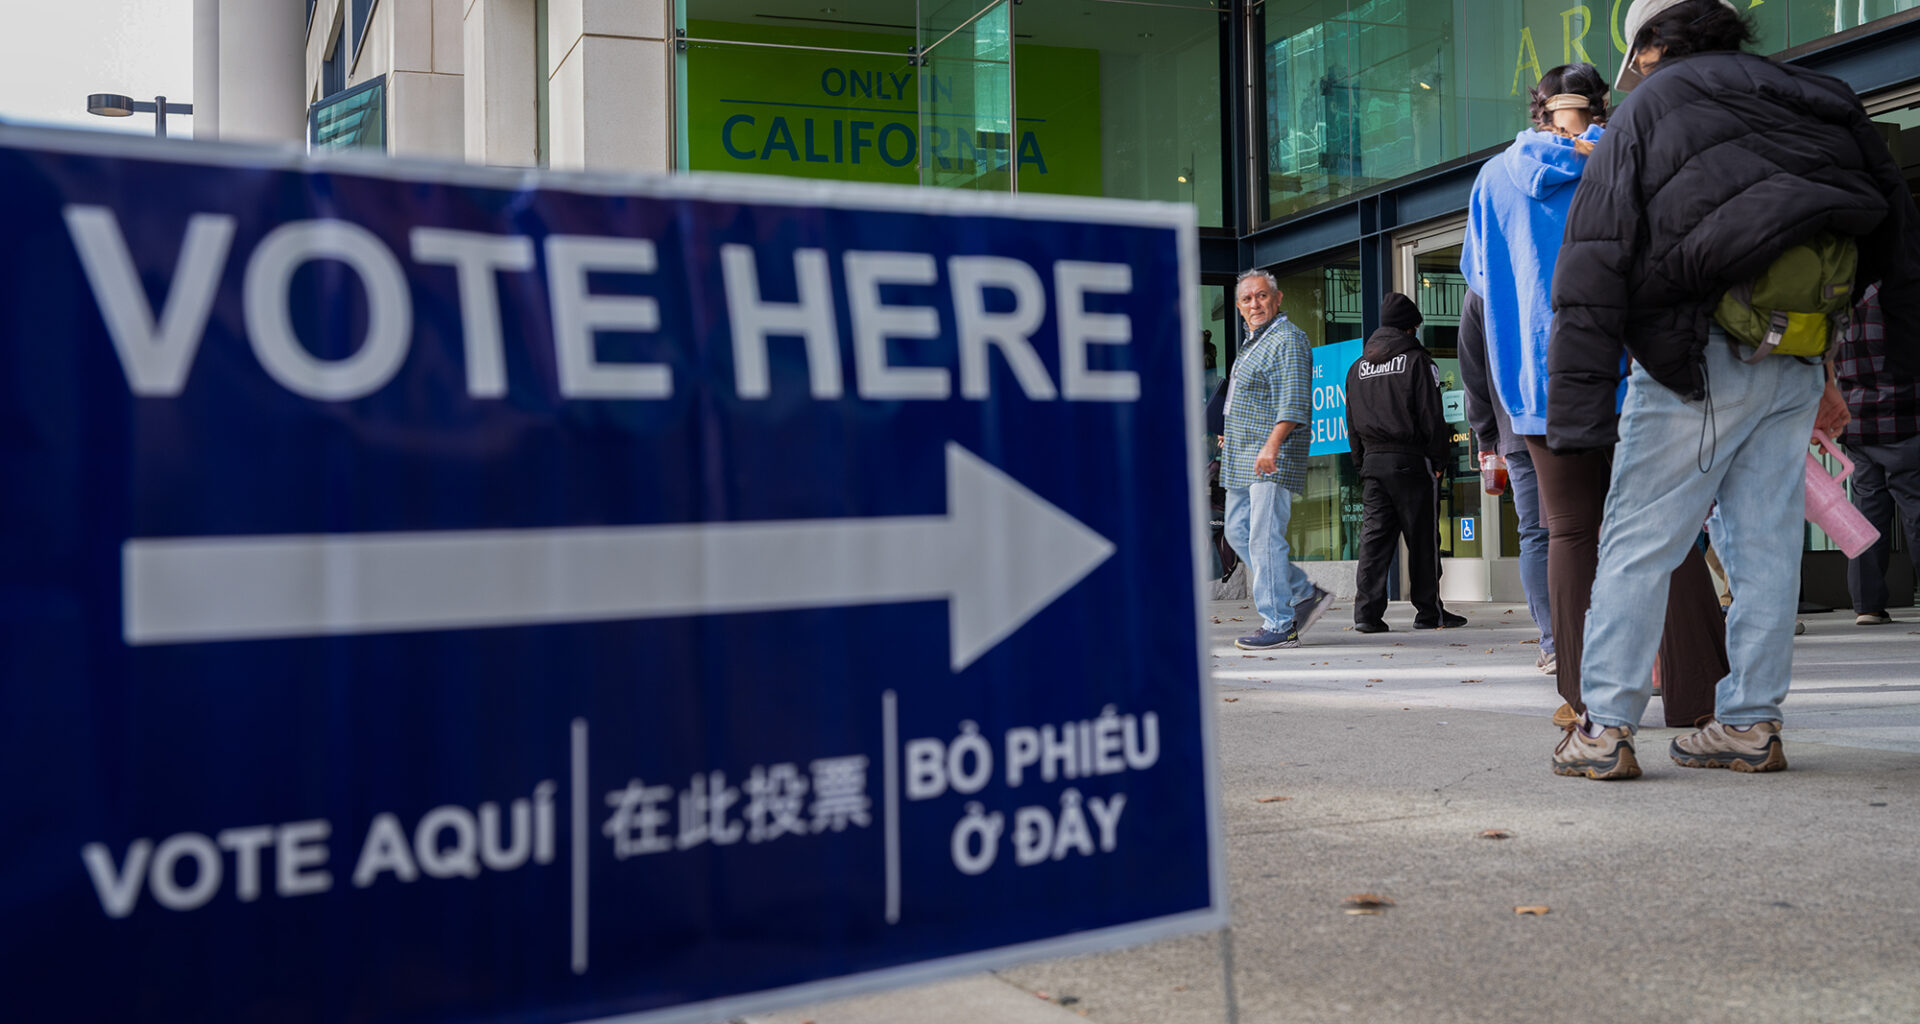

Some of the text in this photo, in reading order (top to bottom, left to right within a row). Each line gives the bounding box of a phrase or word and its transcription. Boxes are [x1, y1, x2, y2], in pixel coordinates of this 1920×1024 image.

[821, 68, 953, 103] ONLY IN
[721, 113, 1048, 175] CALIFORNIA
[66, 205, 1141, 402] VOTE HERE
[904, 719, 994, 801] BỎ
[603, 755, 871, 859] 在此投票
[1011, 787, 1128, 867] ĐÂY
[82, 779, 558, 919] VOTE AQUÍ
